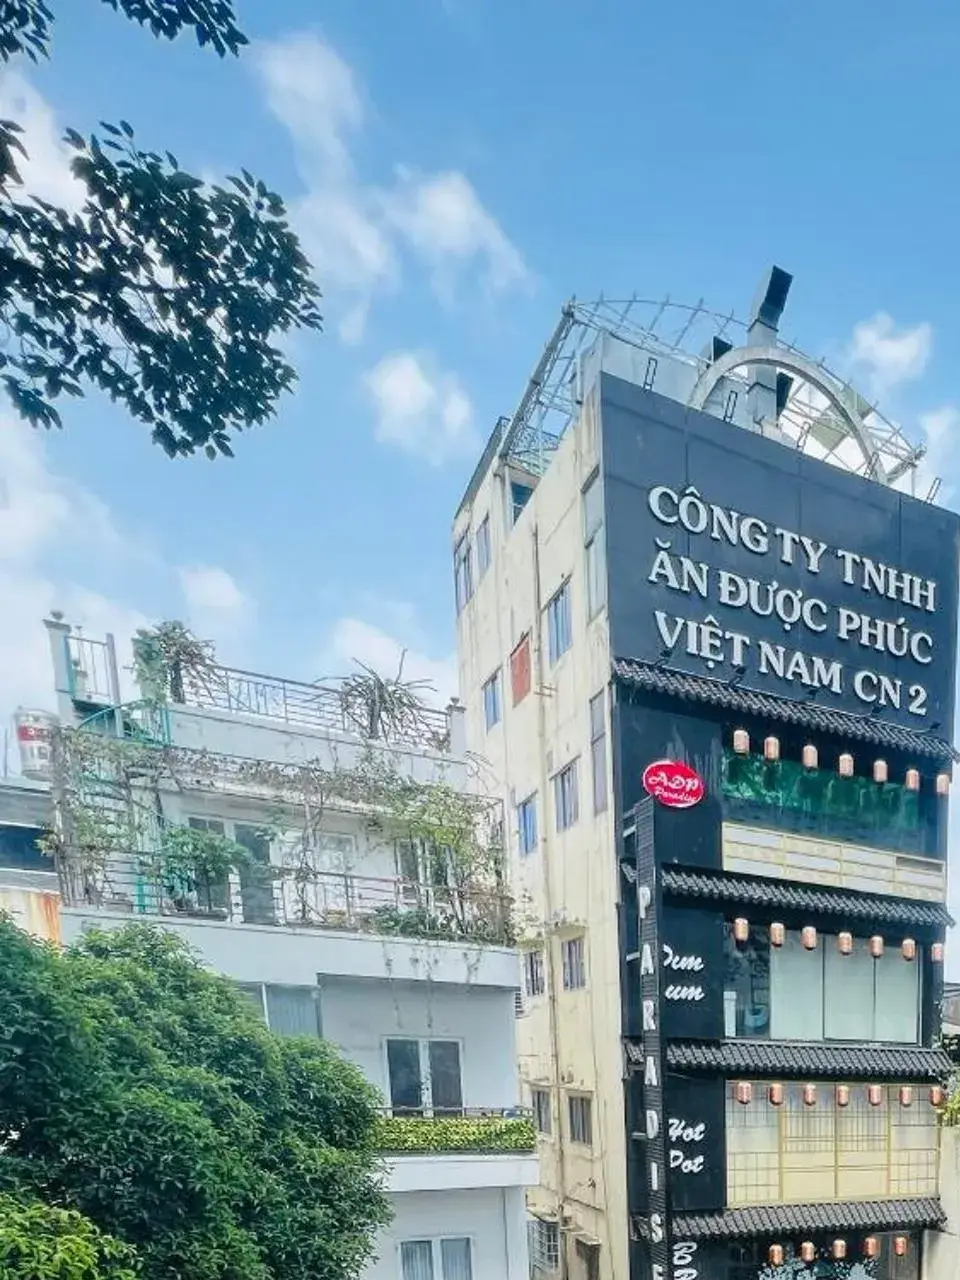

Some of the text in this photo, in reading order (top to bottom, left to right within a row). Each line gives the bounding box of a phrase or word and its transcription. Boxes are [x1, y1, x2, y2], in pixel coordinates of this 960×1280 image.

[648, 485, 937, 613] CÔNG TY TNHH
[648, 537, 933, 664] ĂN ĐƯỢC PHÚC
[654, 610, 928, 716] VIỆT NAM CN 2
